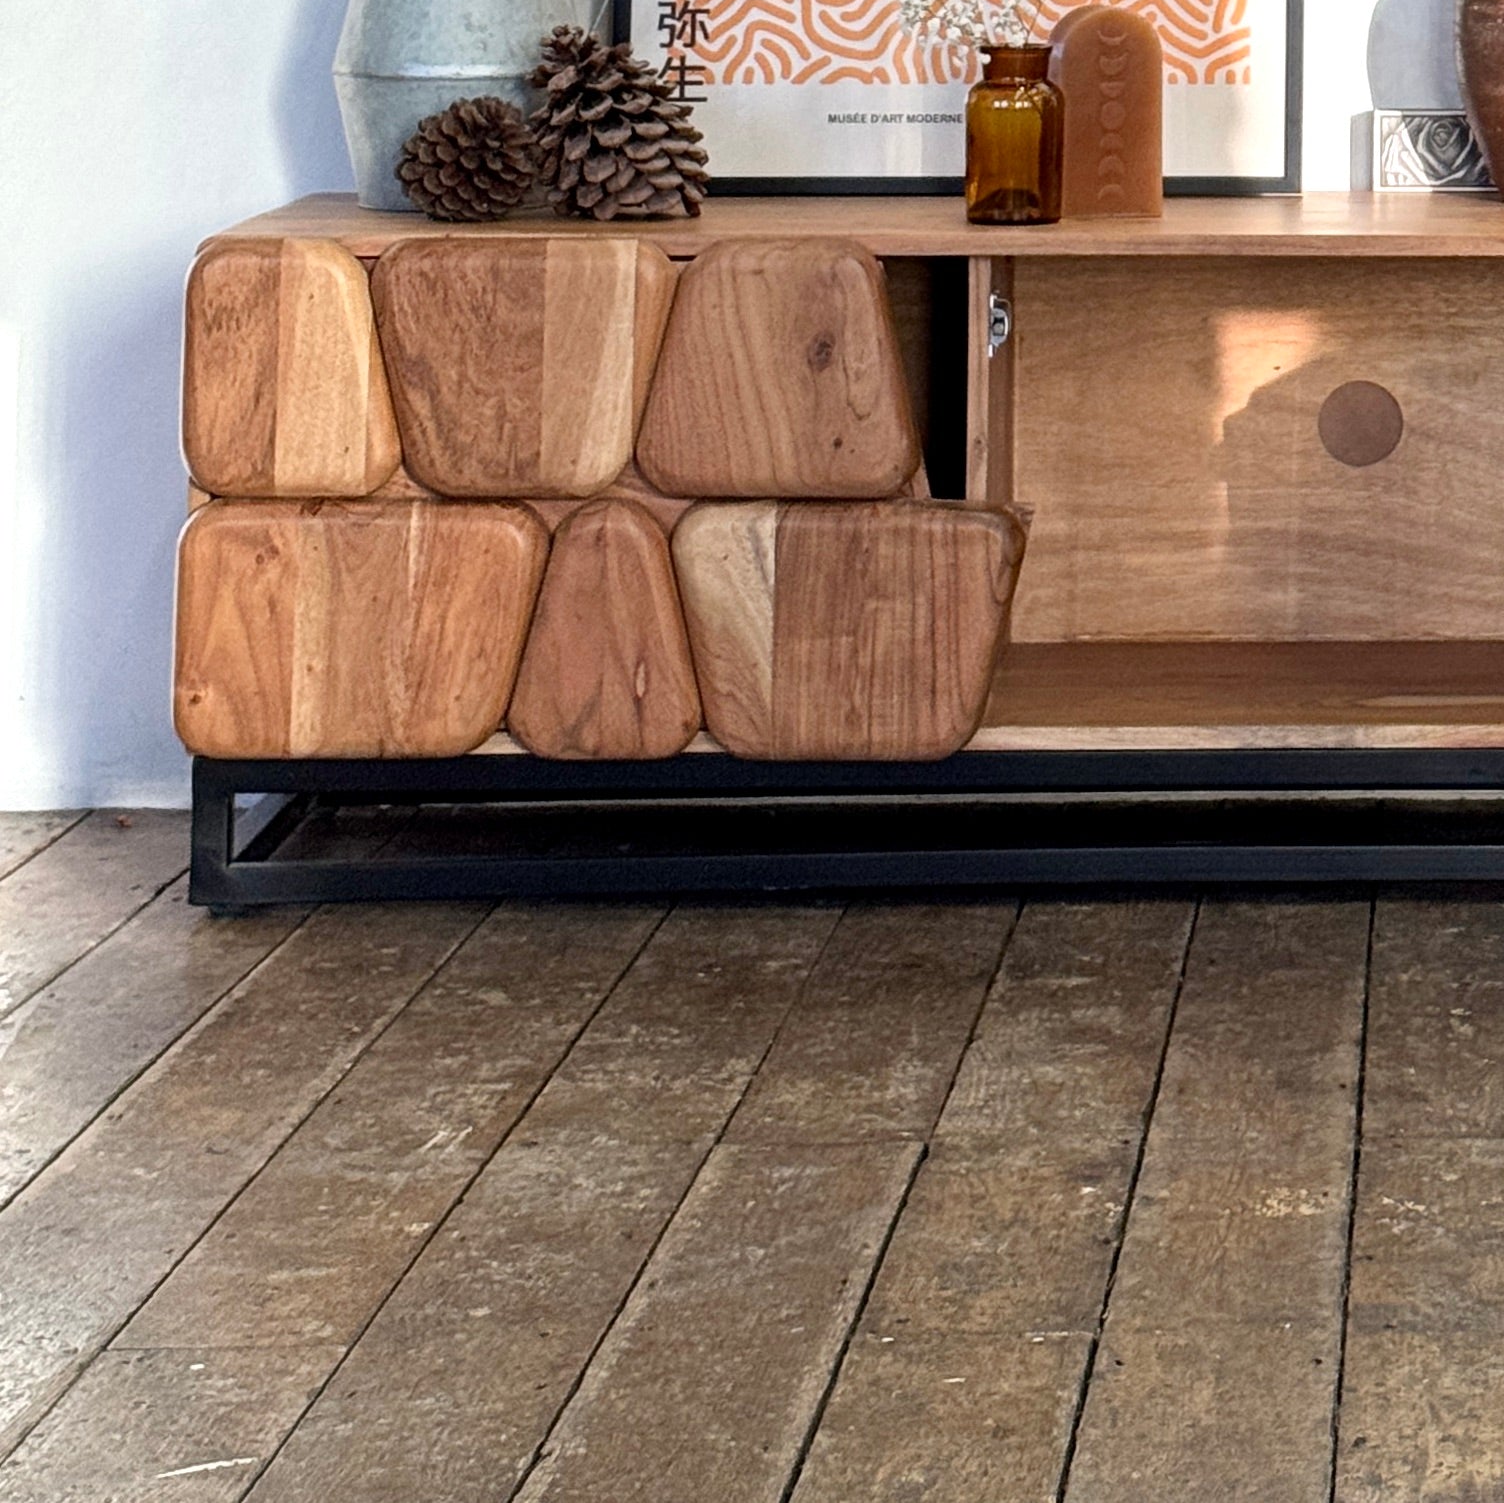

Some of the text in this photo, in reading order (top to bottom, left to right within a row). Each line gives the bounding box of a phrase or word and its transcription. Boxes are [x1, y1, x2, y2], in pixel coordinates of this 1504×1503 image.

[828, 112, 964, 124] MUSÉE D'ART MODERNE
